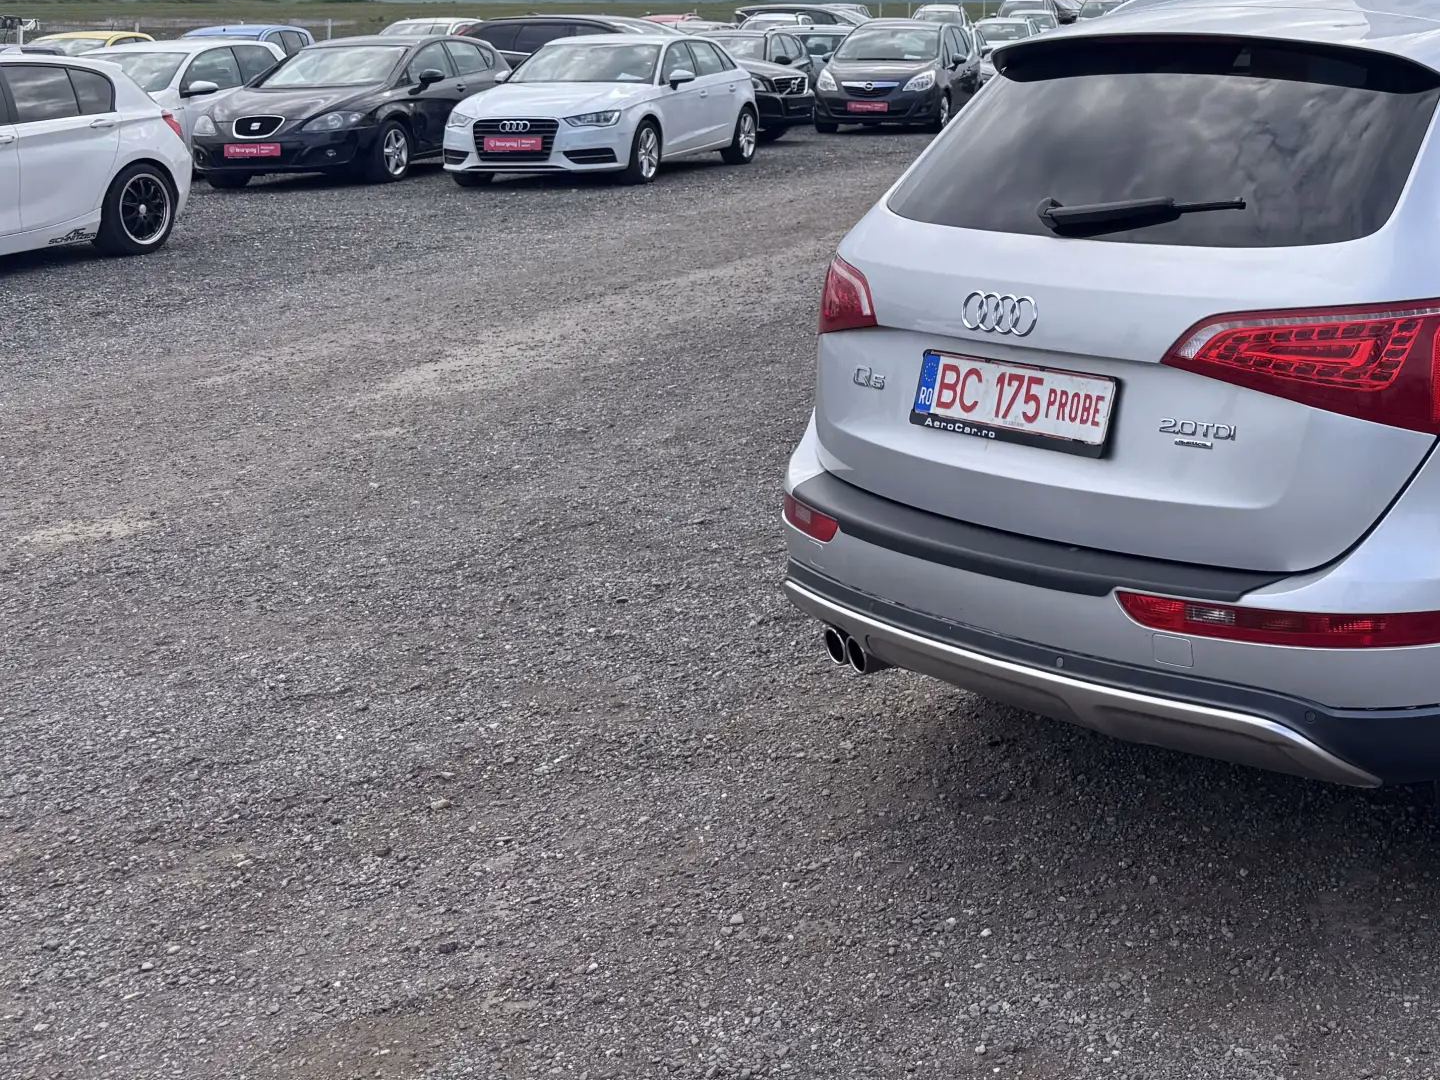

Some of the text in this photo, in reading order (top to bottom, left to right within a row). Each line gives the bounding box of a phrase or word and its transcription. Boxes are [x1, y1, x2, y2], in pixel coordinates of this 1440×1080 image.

[853, 365, 886, 390] Q5
[918, 387, 933, 405] RO
[935, 363, 1105, 427] BC 175 PROBE
[924, 417, 996, 439] AeroCar.ro
